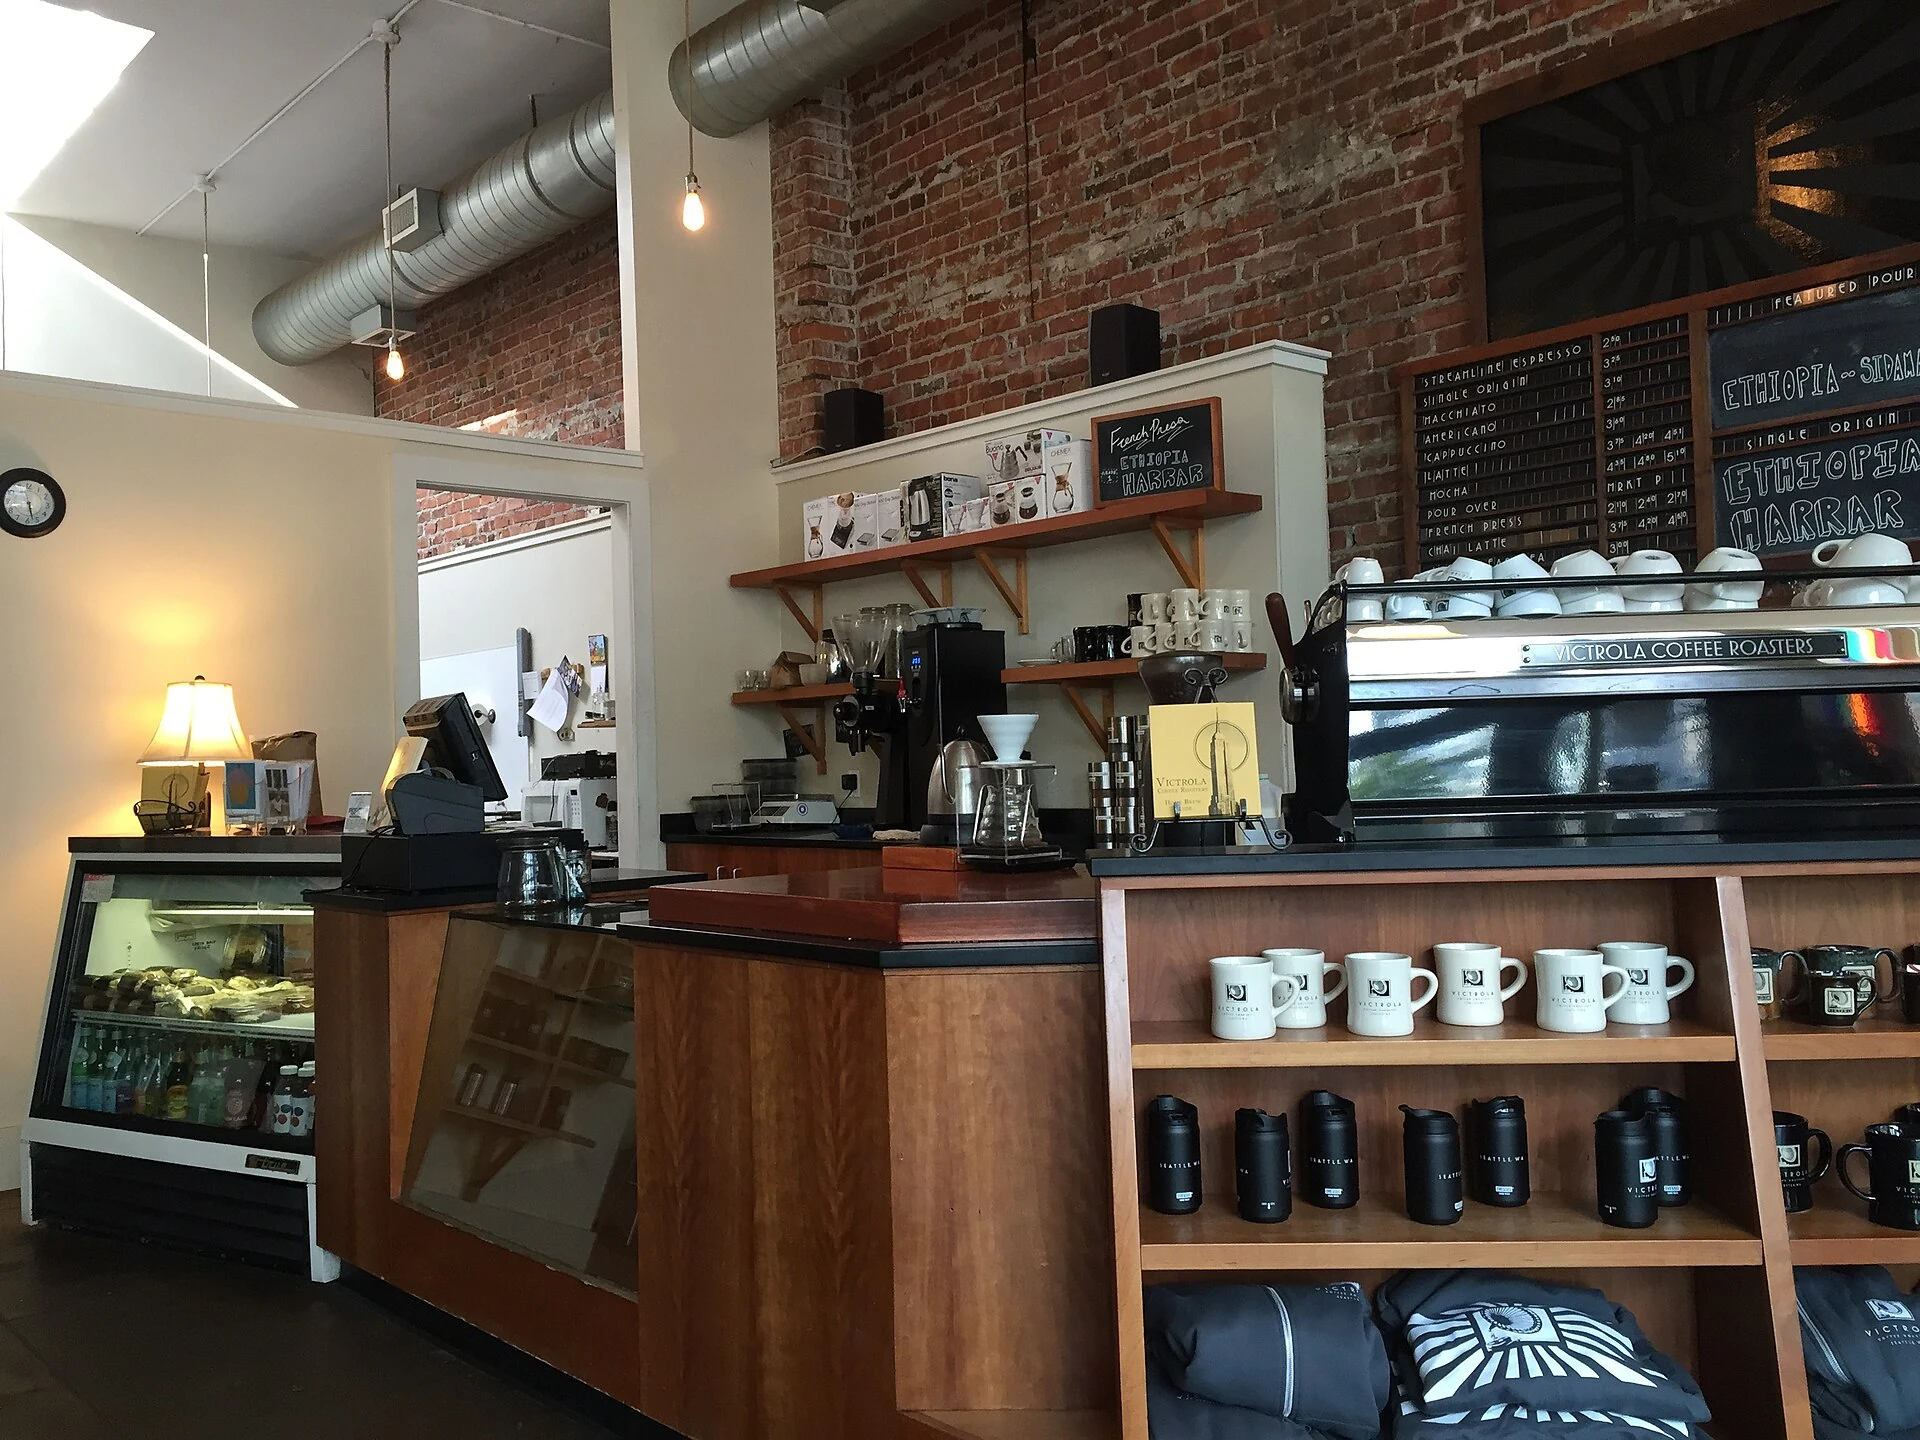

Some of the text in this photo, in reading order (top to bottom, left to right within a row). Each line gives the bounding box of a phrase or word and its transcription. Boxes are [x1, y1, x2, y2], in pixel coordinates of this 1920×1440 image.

[1775, 268, 1914, 310] FEATURED POUR
[1424, 345, 1581, 387] STREAMLINE ESPRESSO
[1423, 375, 1526, 407] SINGLE ORIGIN
[1722, 363, 1839, 410] ETHIOPIA
[1424, 402, 1496, 425] MACCHIATO
[1110, 425, 1149, 453] French
[1424, 423, 1496, 444] AMERICANO
[1747, 412, 1896, 450] SINGLE ORIGIN
[1120, 450, 1189, 470] ETHIOPIA
[1426, 440, 1506, 462] CAPPUCCINO
[1122, 464, 1204, 496] HARRAR
[1427, 465, 1467, 480] LATTE
[1723, 437, 1920, 506] ETHIOPIA
[1429, 486, 1467, 500] MOCHA
[1607, 477, 1641, 493] MRKT
[1427, 501, 1497, 519] POUR OVER
[1730, 489, 1904, 551] HARRAR
[1428, 516, 1522, 537] FRENCH PRESS
[1428, 538, 1506, 557] CHAI LATTE
[1552, 637, 1815, 661] VICTROLA COFFEE ROASTERS
[1156, 777, 1207, 787] VICTROLA
